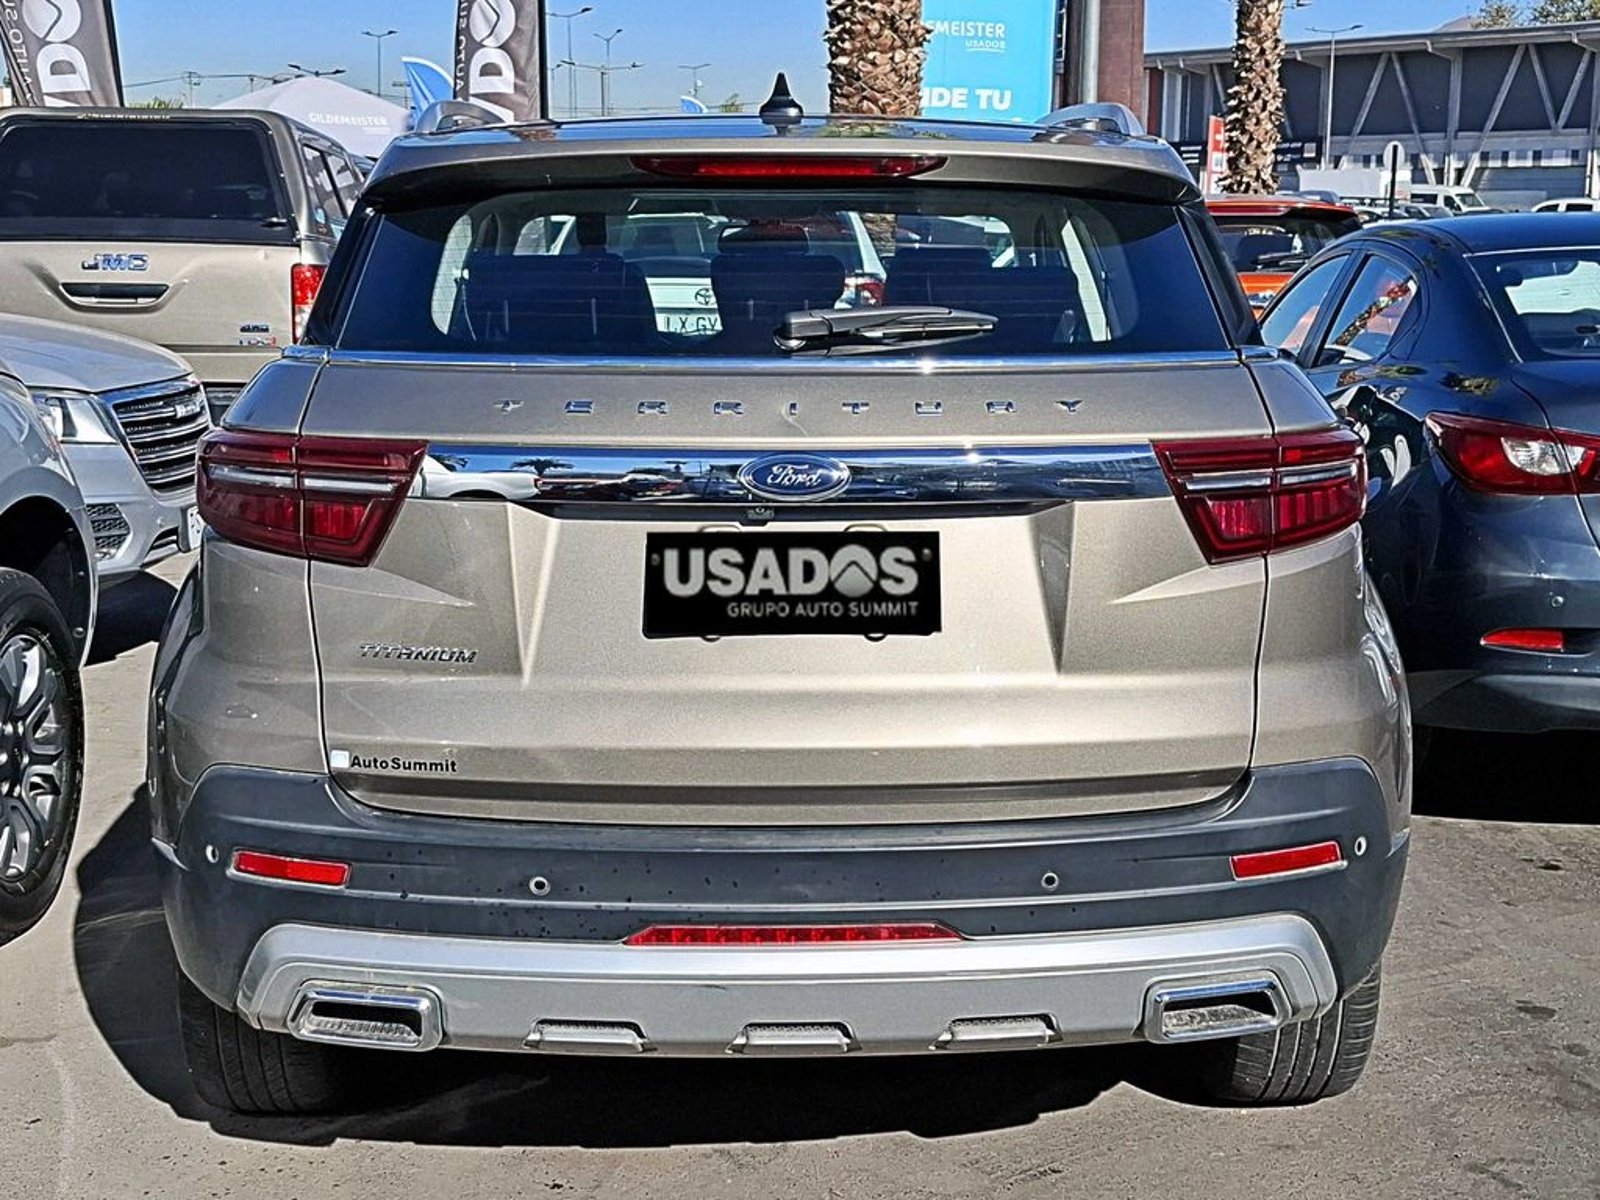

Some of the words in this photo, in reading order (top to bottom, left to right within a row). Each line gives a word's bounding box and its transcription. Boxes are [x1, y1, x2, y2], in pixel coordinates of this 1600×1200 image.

[924, 20, 1006, 38] MEISTER
[965, 39, 1006, 49] USADOS
[975, 88, 1012, 111] TU
[81, 253, 149, 271] JMC
[493, 399, 1083, 415] TERRITORY
[766, 462, 822, 487] Ford
[359, 644, 478, 664] TITANIUM
